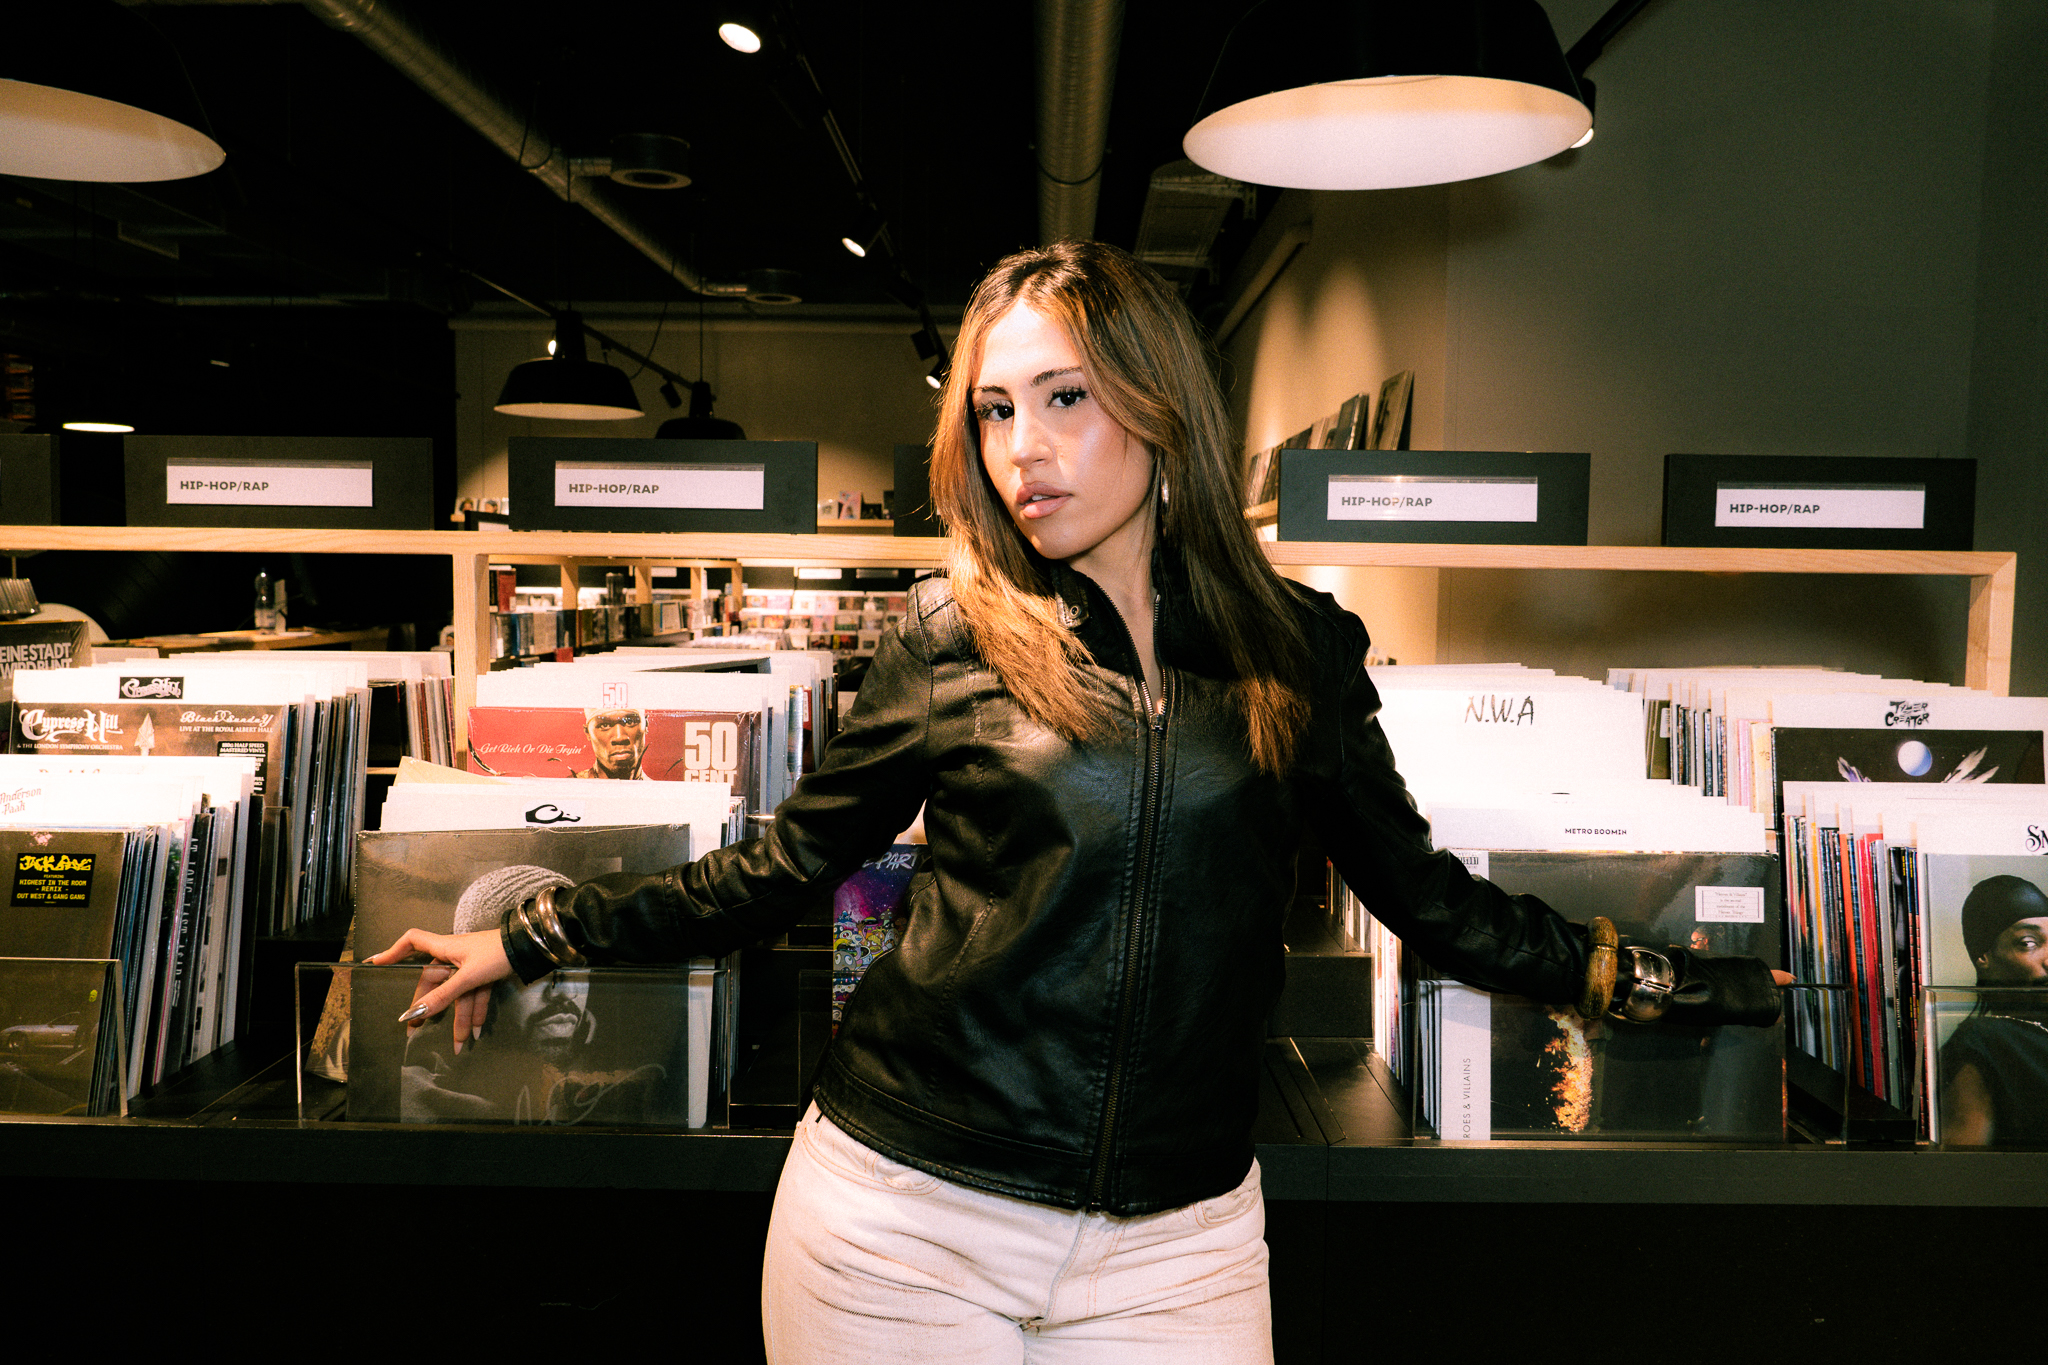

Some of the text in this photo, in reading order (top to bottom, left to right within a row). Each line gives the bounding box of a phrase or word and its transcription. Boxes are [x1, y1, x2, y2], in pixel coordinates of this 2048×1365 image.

[180, 480, 269, 492] HIP-HOP/RAP
[569, 483, 660, 495] HIP-HOP/RAP
[1341, 496, 1433, 508] HIP-HOP/RAP
[1729, 503, 1821, 515] HIP-HOP/RAP
[602, 682, 628, 705] 50
[1465, 694, 1534, 726] N.W.A
[19, 709, 123, 743] Cypress Hill
[478, 743, 498, 754] Get
[498, 743, 521, 754] Rich
[522, 743, 535, 754] Or
[536, 743, 554, 754] Die
[685, 721, 738, 770] 50
[684, 769, 738, 785] CENT
[1594, 828, 1627, 836] BOOMIN
[1462, 1057, 1471, 1100] VILLAINS
